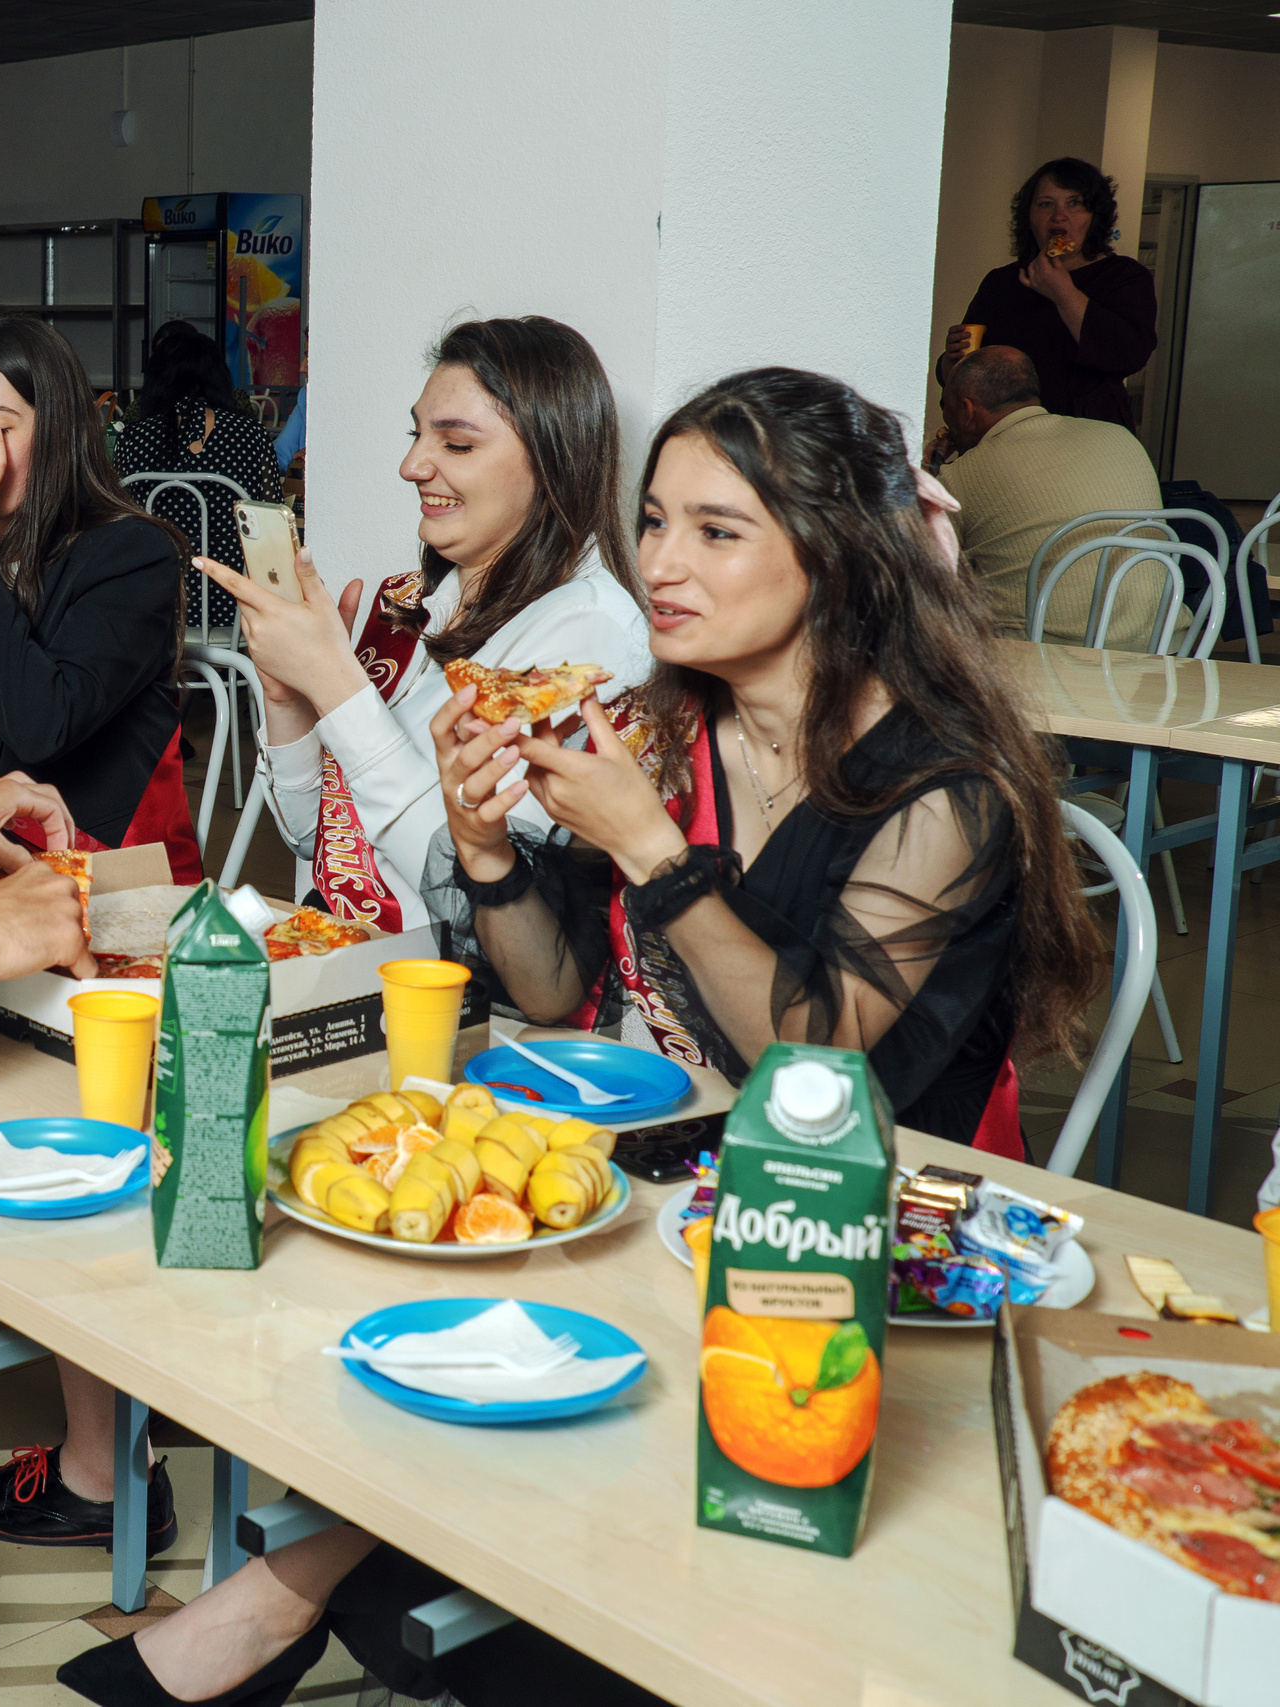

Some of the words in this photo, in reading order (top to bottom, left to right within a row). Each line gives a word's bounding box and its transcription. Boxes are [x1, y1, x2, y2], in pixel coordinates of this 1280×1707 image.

[269, 1038, 310, 1055] хтамукай,
[360, 1024, 366, 1033] 7
[270, 1031, 304, 1047] дыгейск,
[325, 1018, 356, 1031] Ленина,
[360, 1014, 365, 1023] 1
[269, 1048, 310, 1065] онежукай,
[324, 1040, 347, 1053] Мира,
[349, 1036, 358, 1046] 14
[713, 1192, 883, 1263] Добрый
